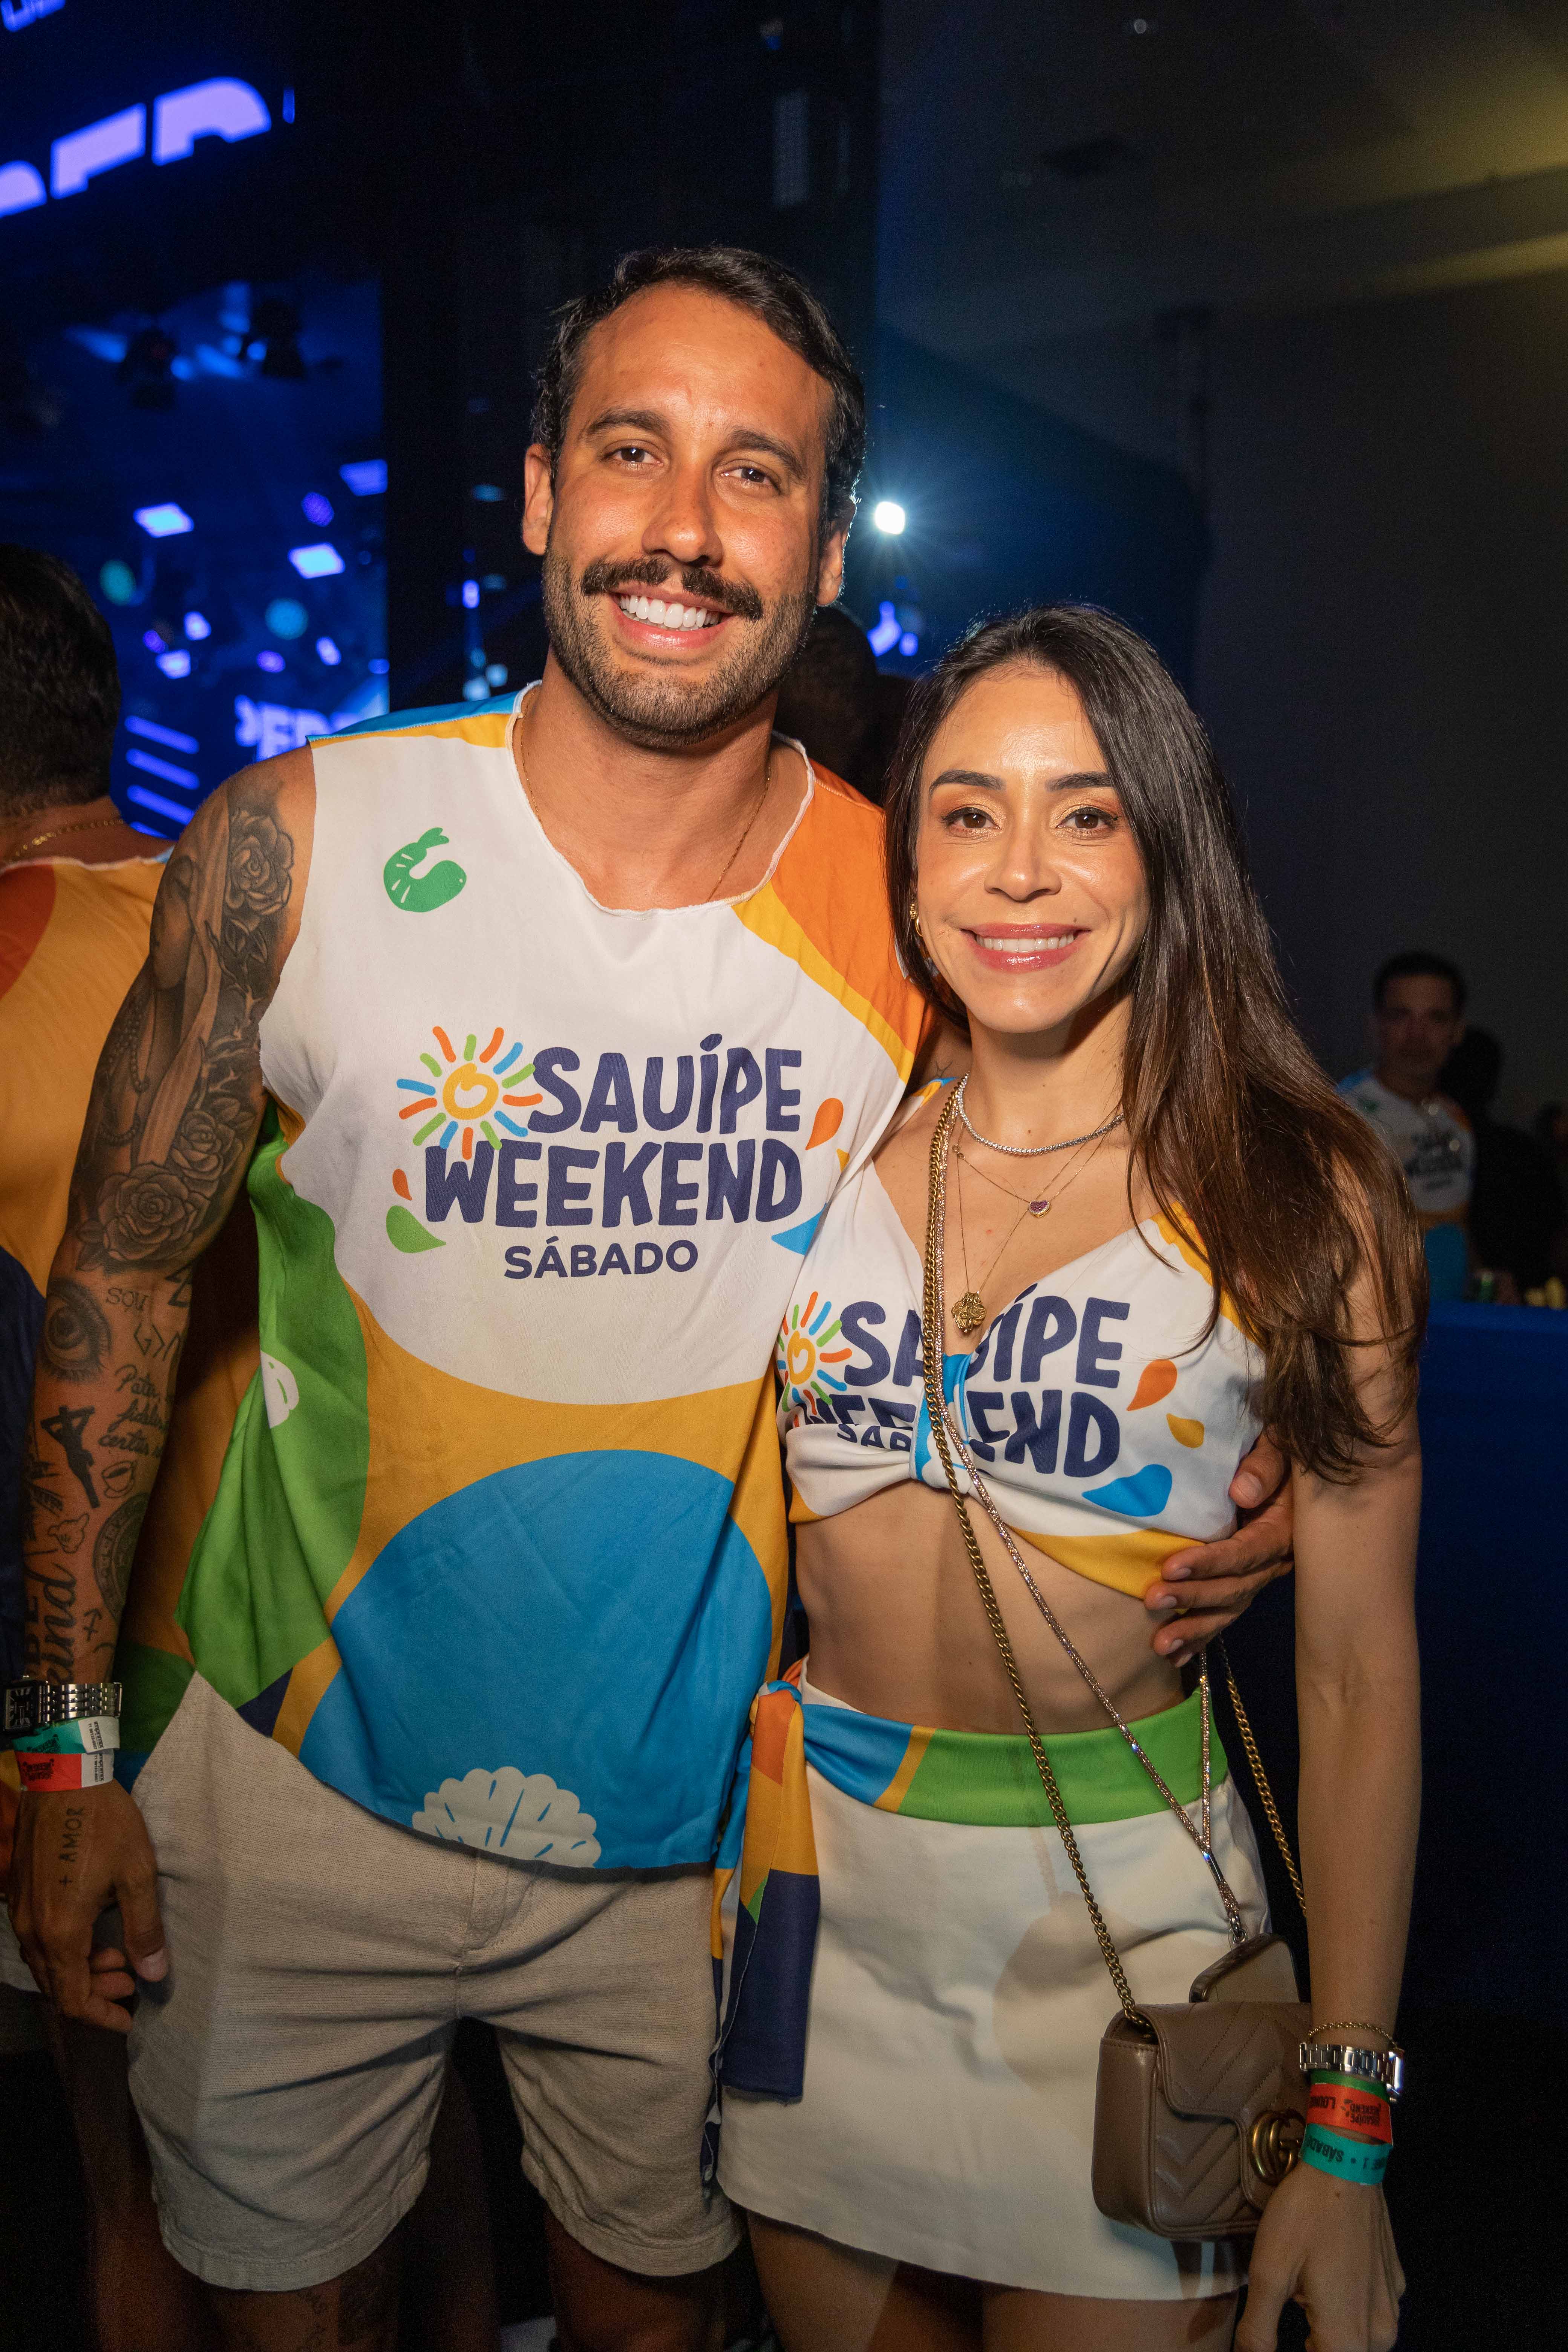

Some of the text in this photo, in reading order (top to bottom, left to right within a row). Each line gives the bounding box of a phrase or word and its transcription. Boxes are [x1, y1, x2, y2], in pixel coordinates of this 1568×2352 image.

[528, 1034, 802, 1134] SAUÍPE
[425, 1138, 802, 1228] WEEKEND
[504, 1236, 698, 1279] SÁBADO
